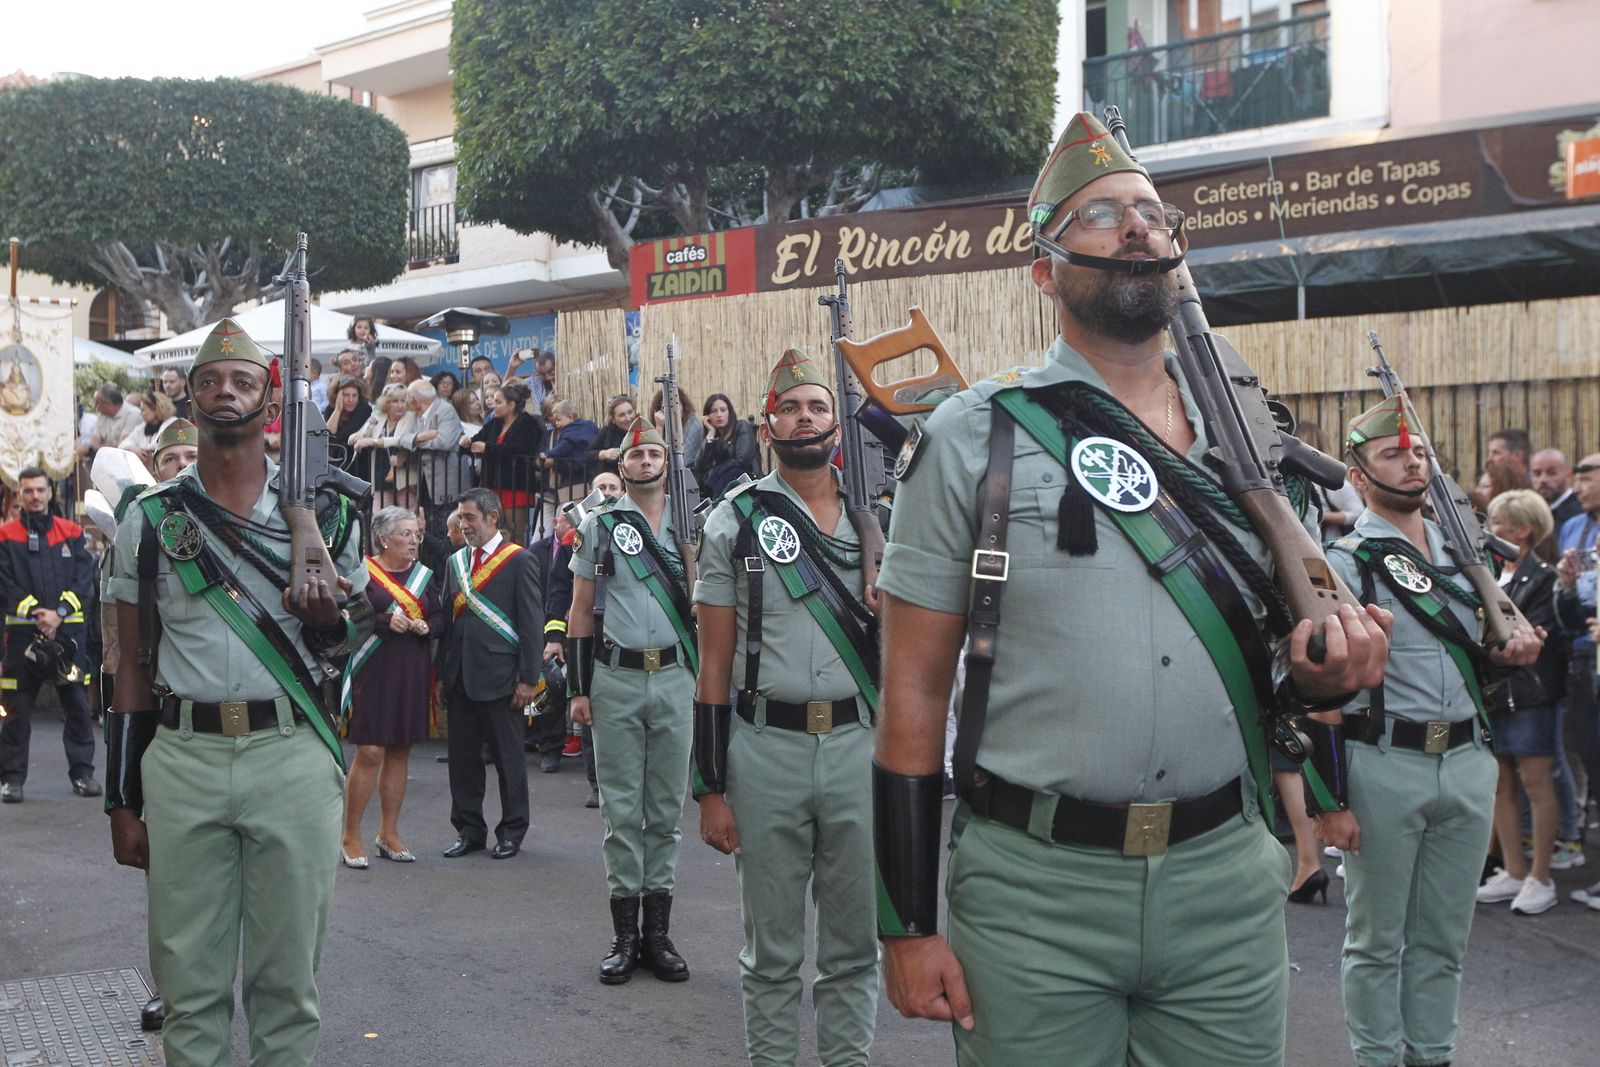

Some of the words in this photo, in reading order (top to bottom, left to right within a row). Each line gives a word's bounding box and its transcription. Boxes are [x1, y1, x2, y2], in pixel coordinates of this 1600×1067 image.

[1305, 171, 1342, 192] Bar
[1346, 164, 1374, 186] de
[1377, 159, 1441, 183] Tapas
[1181, 207, 1248, 231] elados
[1269, 190, 1379, 220] Meriendas
[1402, 181, 1472, 205] Copas
[666, 246, 706, 264] cafés
[771, 229, 821, 285] El
[838, 219, 972, 275] Rincón
[484, 340, 499, 358] DE
